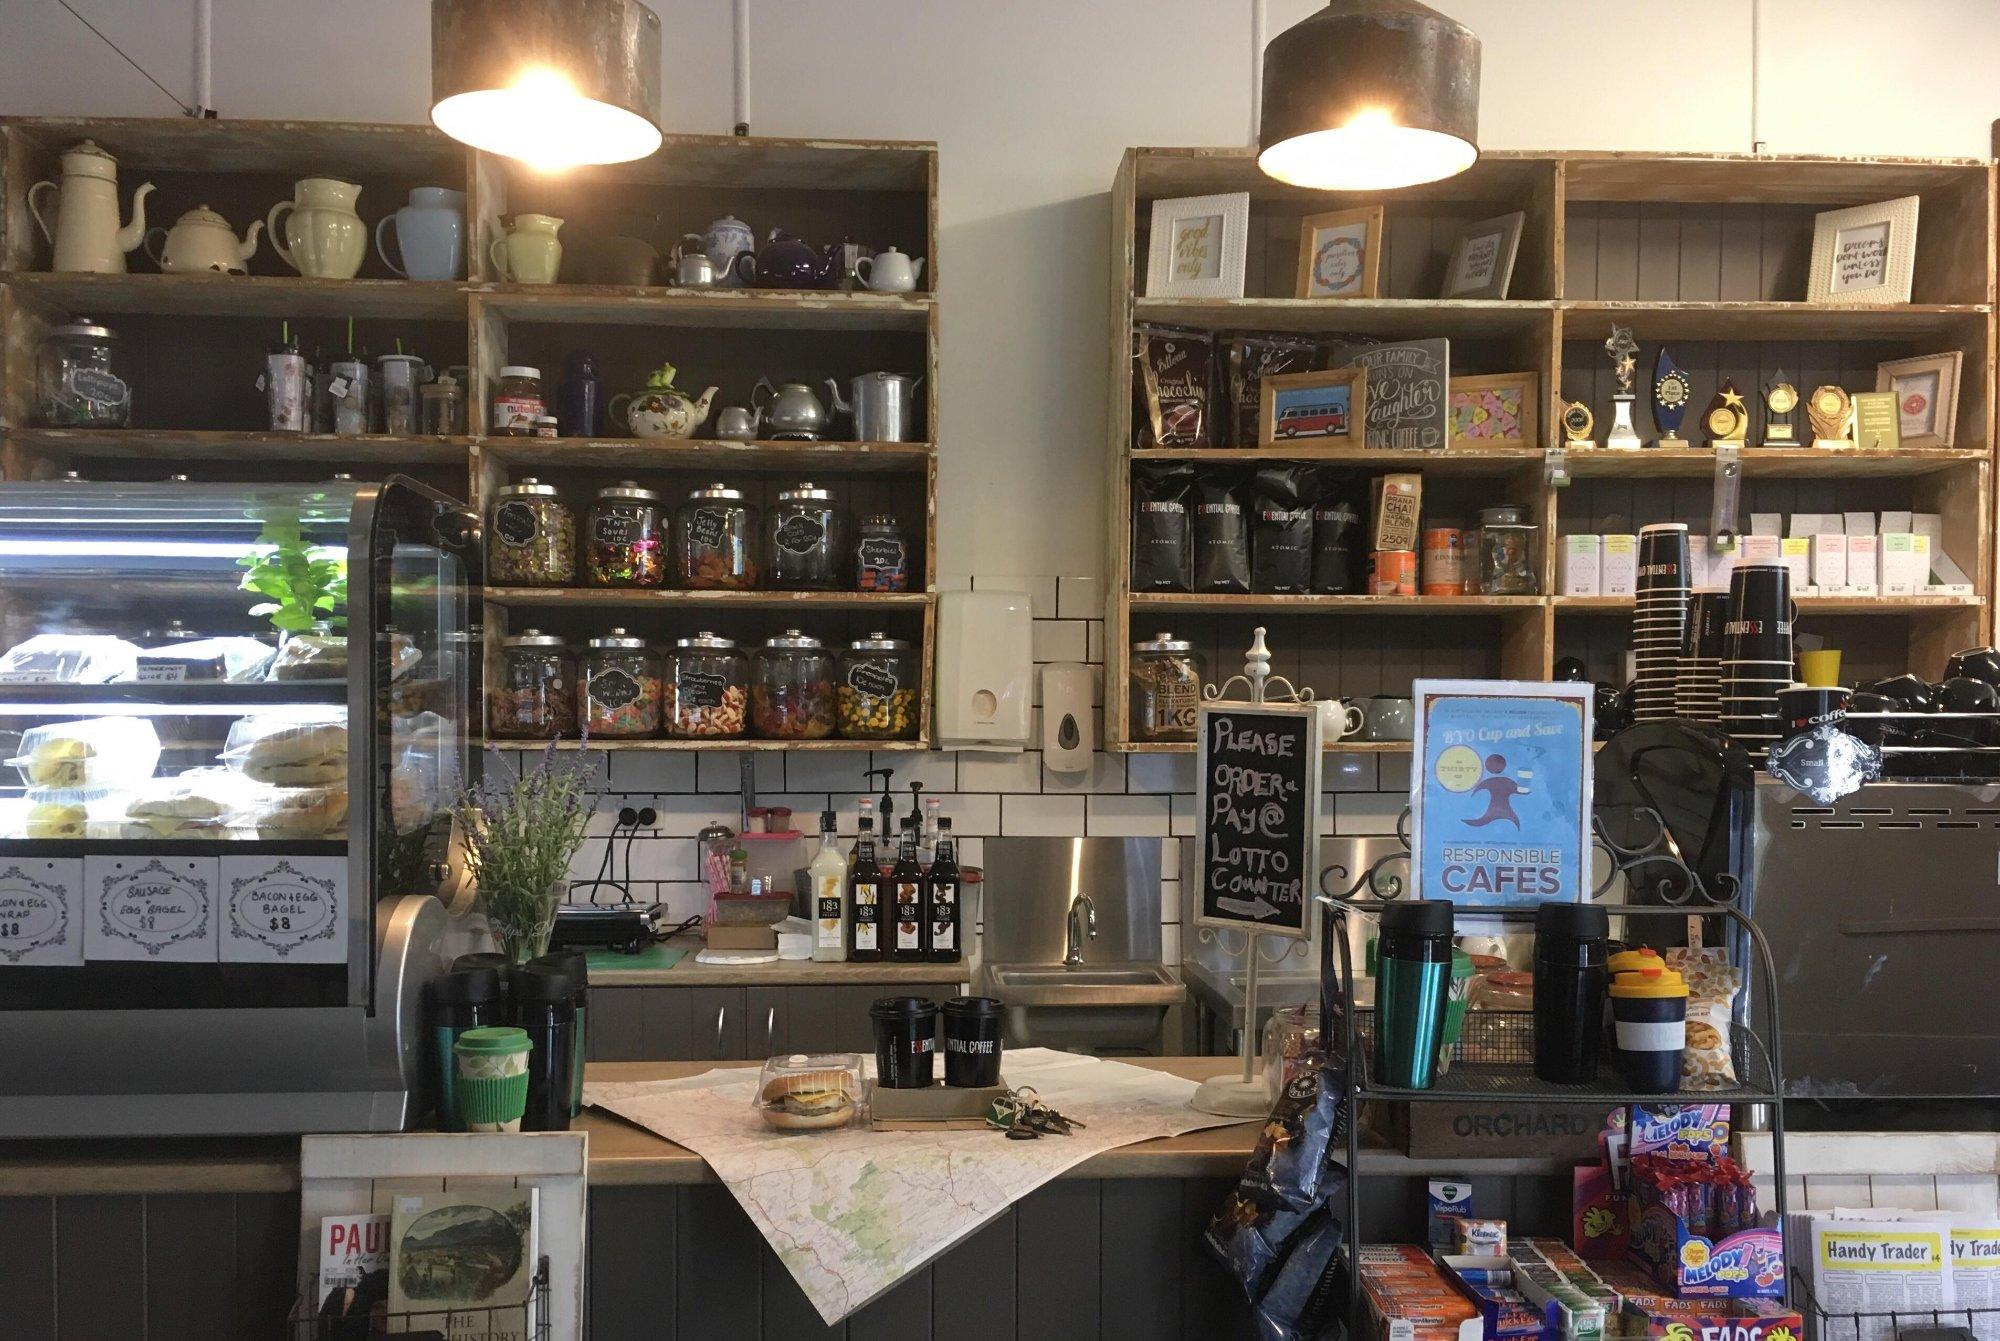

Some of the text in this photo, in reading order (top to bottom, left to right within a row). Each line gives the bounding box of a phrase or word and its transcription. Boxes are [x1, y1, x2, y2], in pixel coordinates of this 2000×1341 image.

[1177, 240, 1207, 259] vibes
[1177, 260, 1202, 280] only
[1362, 350, 1421, 369] OUR FAMILY
[1400, 366, 1413, 378] ON
[1141, 501, 1168, 513] ESSENTIAL
[1198, 503, 1224, 514] ESSENTIAL
[1386, 502, 1411, 514] CHAI
[605, 517, 629, 526] TNT
[1384, 519, 1410, 528] BLEND
[1647, 563, 1677, 575] ESSENTIAL
[1159, 683, 1196, 694] BLEND
[1158, 708, 1196, 727] 1KG
[1478, 726, 1503, 743] Cup
[1505, 724, 1531, 739] and
[1534, 721, 1564, 736] Save
[1800, 759, 1824, 767] Small
[1442, 847, 1560, 864] RESPONSIBLE
[1441, 865, 1561, 895] CAFES
[126, 885, 172, 898] SAUSAGE
[252, 890, 287, 902] BACON
[296, 891, 318, 902] EGG
[27, 898, 48, 908] EGG
[119, 904, 186, 915] EGG BAGEL
[262, 903, 306, 915] BAGEL
[1, 922, 20, 937] $8
[270, 917, 291, 931] $8
[968, 1040, 994, 1055] COFFEE
[1453, 1112, 1590, 1138] ORCHARD
[1645, 1110, 1703, 1142] MELODY
[1678, 1128, 1713, 1141] POPS
[1433, 1203, 1467, 1213] VapoRub
[1827, 1240, 1877, 1262] Handy
[1880, 1241, 1929, 1260] Trader
[1685, 1248, 1744, 1284] MELODY
[1716, 1267, 1749, 1281] POPS
[1664, 1301, 1693, 1310] FADS
[1700, 1300, 1728, 1309] FADS
[441, 1315, 476, 1329] THE
